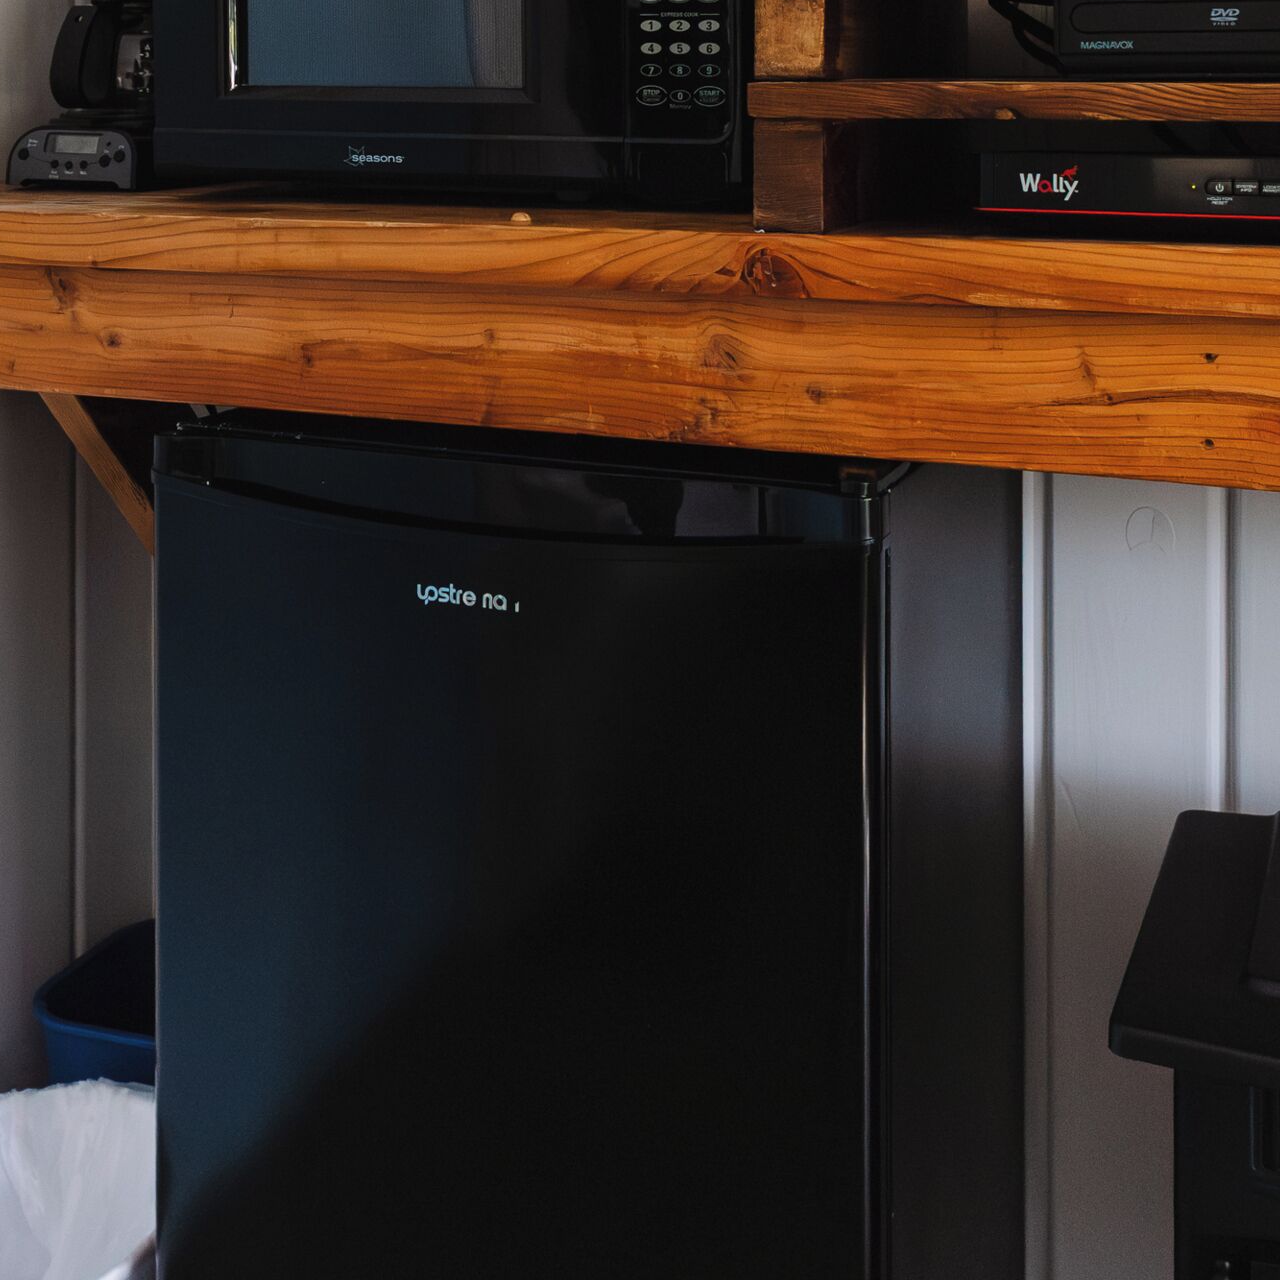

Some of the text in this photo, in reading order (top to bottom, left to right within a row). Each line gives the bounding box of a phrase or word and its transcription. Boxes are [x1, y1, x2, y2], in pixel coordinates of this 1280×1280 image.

[1210, 8, 1240, 17] DVD
[647, 21, 653, 30] 1
[676, 21, 683, 31] 2
[705, 21, 712, 31] 3
[647, 43, 655, 53] 4
[676, 44, 683, 53] 5
[706, 44, 713, 54] 6
[1080, 40, 1134, 50] MAGNAVOX
[648, 66, 655, 75] 7
[676, 66, 683, 75] 8
[706, 66, 713, 75] 9
[351, 154, 403, 164] seasons
[1019, 171, 1079, 202] Wally
